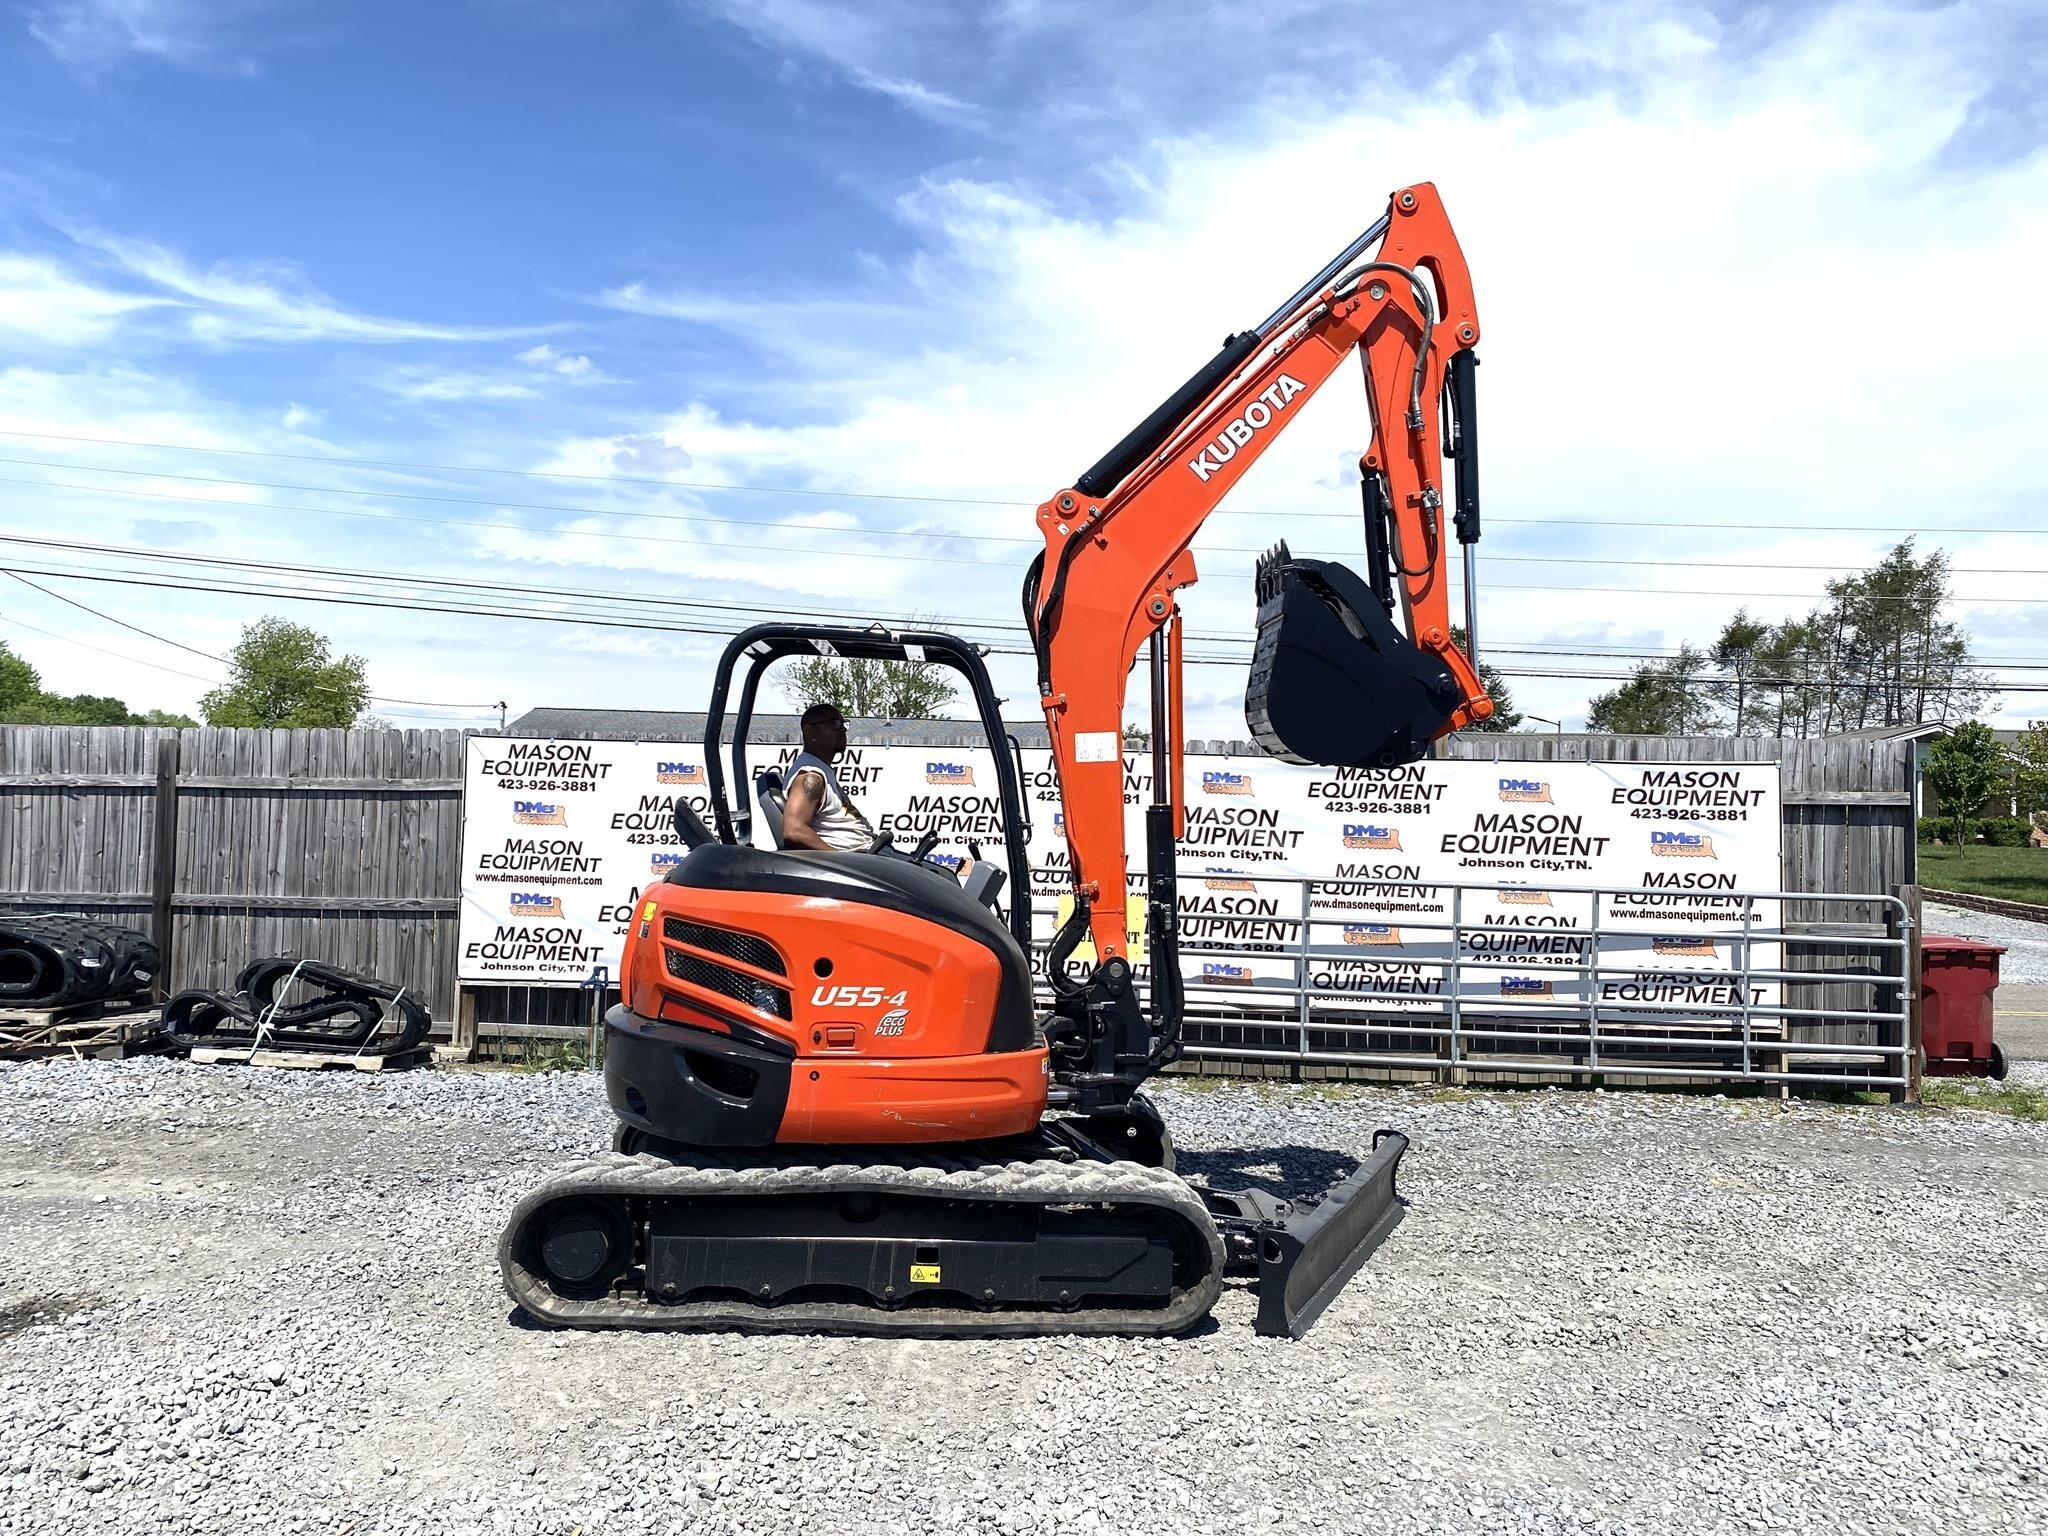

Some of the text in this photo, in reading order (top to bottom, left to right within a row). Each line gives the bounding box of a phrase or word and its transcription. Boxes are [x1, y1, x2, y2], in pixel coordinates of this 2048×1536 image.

[1187, 372, 1307, 483] KUBOTA
[508, 744, 592, 761] MASON
[481, 760, 612, 778] EQUIPMENT
[1335, 766, 1426, 782] MASON
[498, 779, 596, 792] 423-926-3881
[1641, 771, 1740, 788] MASON
[1307, 782, 1448, 801] EQUIPMENT
[1611, 788, 1766, 807] EQUIPMENT
[908, 796, 1001, 814] MASON
[1324, 802, 1431, 815] 423-926-3881
[1183, 806, 1279, 828] MASON
[1630, 808, 1748, 821] 423-926-3881
[878, 814, 1006, 834] EQUIPMEN
[1473, 814, 1582, 834] MASON
[504, 838, 583, 856] MASON
[1176, 827, 1304, 849] UIPMENT
[1440, 834, 1610, 856] EQUIPMENT
[1176, 848, 1225, 858] ohnson
[479, 854, 602, 872] EQUIPMENT
[1335, 863, 1421, 880] MASON
[1458, 857, 1525, 868] Johnson
[475, 873, 603, 886] www.dmasonequipment.com
[1642, 872, 1737, 890] MASON
[1178, 895, 1279, 916] MASON
[494, 926, 583, 944] MASON
[1177, 918, 1302, 942] UIPMENT
[465, 943, 604, 963] EQUIPMENT
[480, 962, 535, 972] Johnson
[811, 986, 908, 1007] U55-4
[1601, 983, 1767, 1006] EQUIPMENT
[874, 1027, 904, 1036] PLUS
